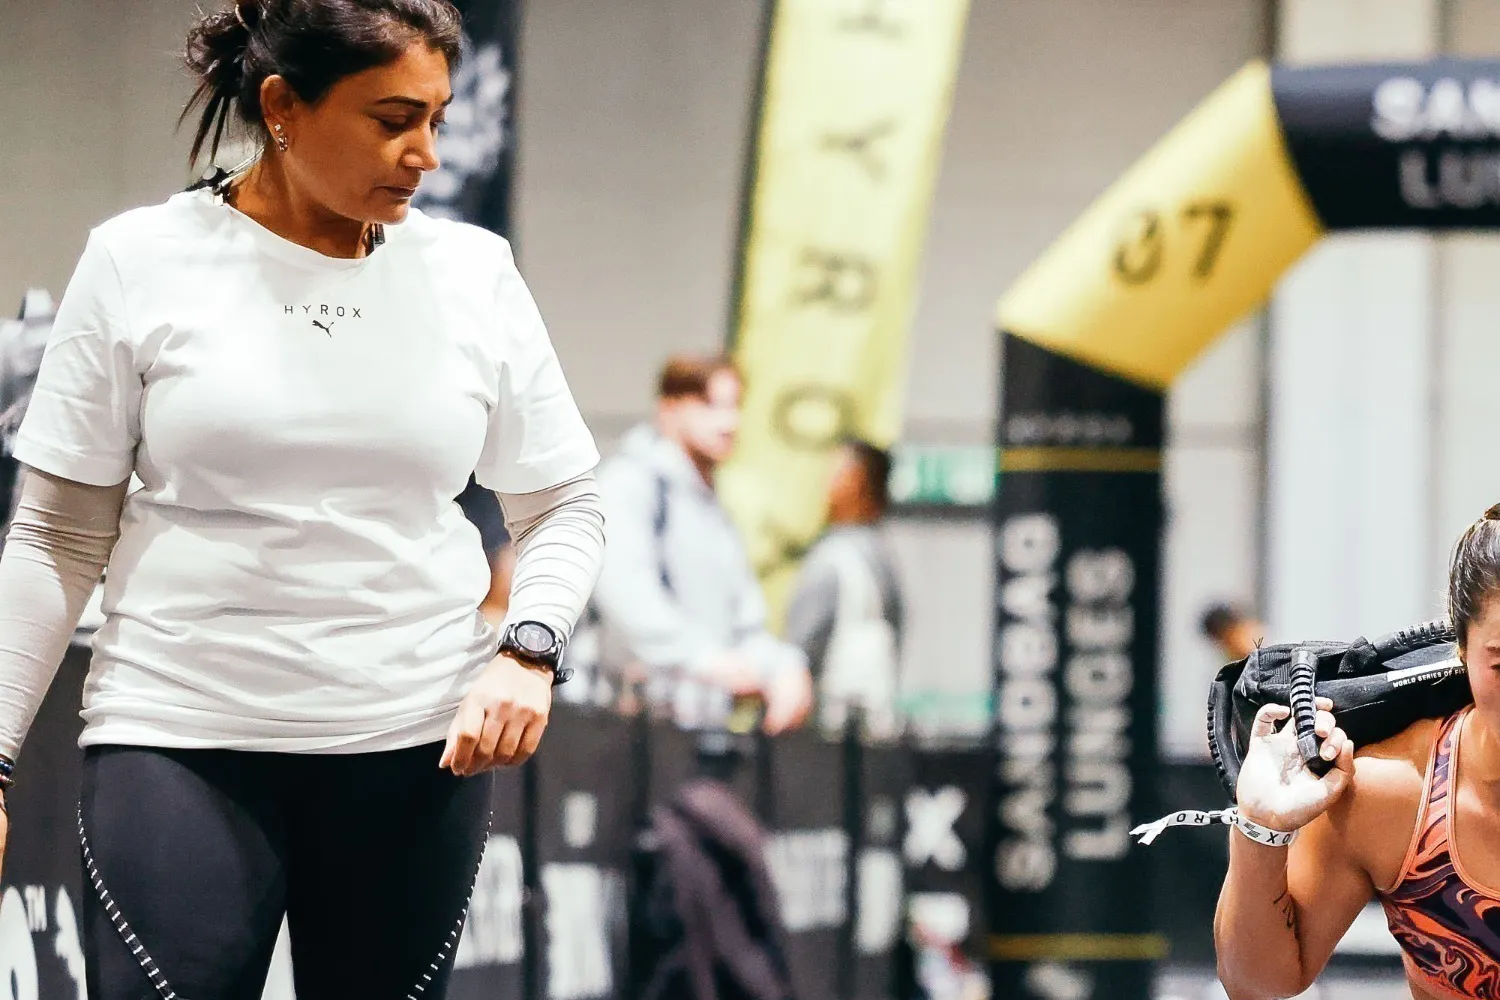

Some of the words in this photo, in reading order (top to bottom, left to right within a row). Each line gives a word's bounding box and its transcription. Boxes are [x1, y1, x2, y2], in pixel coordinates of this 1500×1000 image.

[284, 304, 362, 319] HYROX
[996, 512, 1060, 892] SANDBAG
[1065, 548, 1134, 860] LUNGES
[1392, 677, 1416, 688] WORLD
[1417, 671, 1442, 682] SERIES
[1443, 669, 1453, 677] OF
[1454, 667, 1468, 676] FIT
